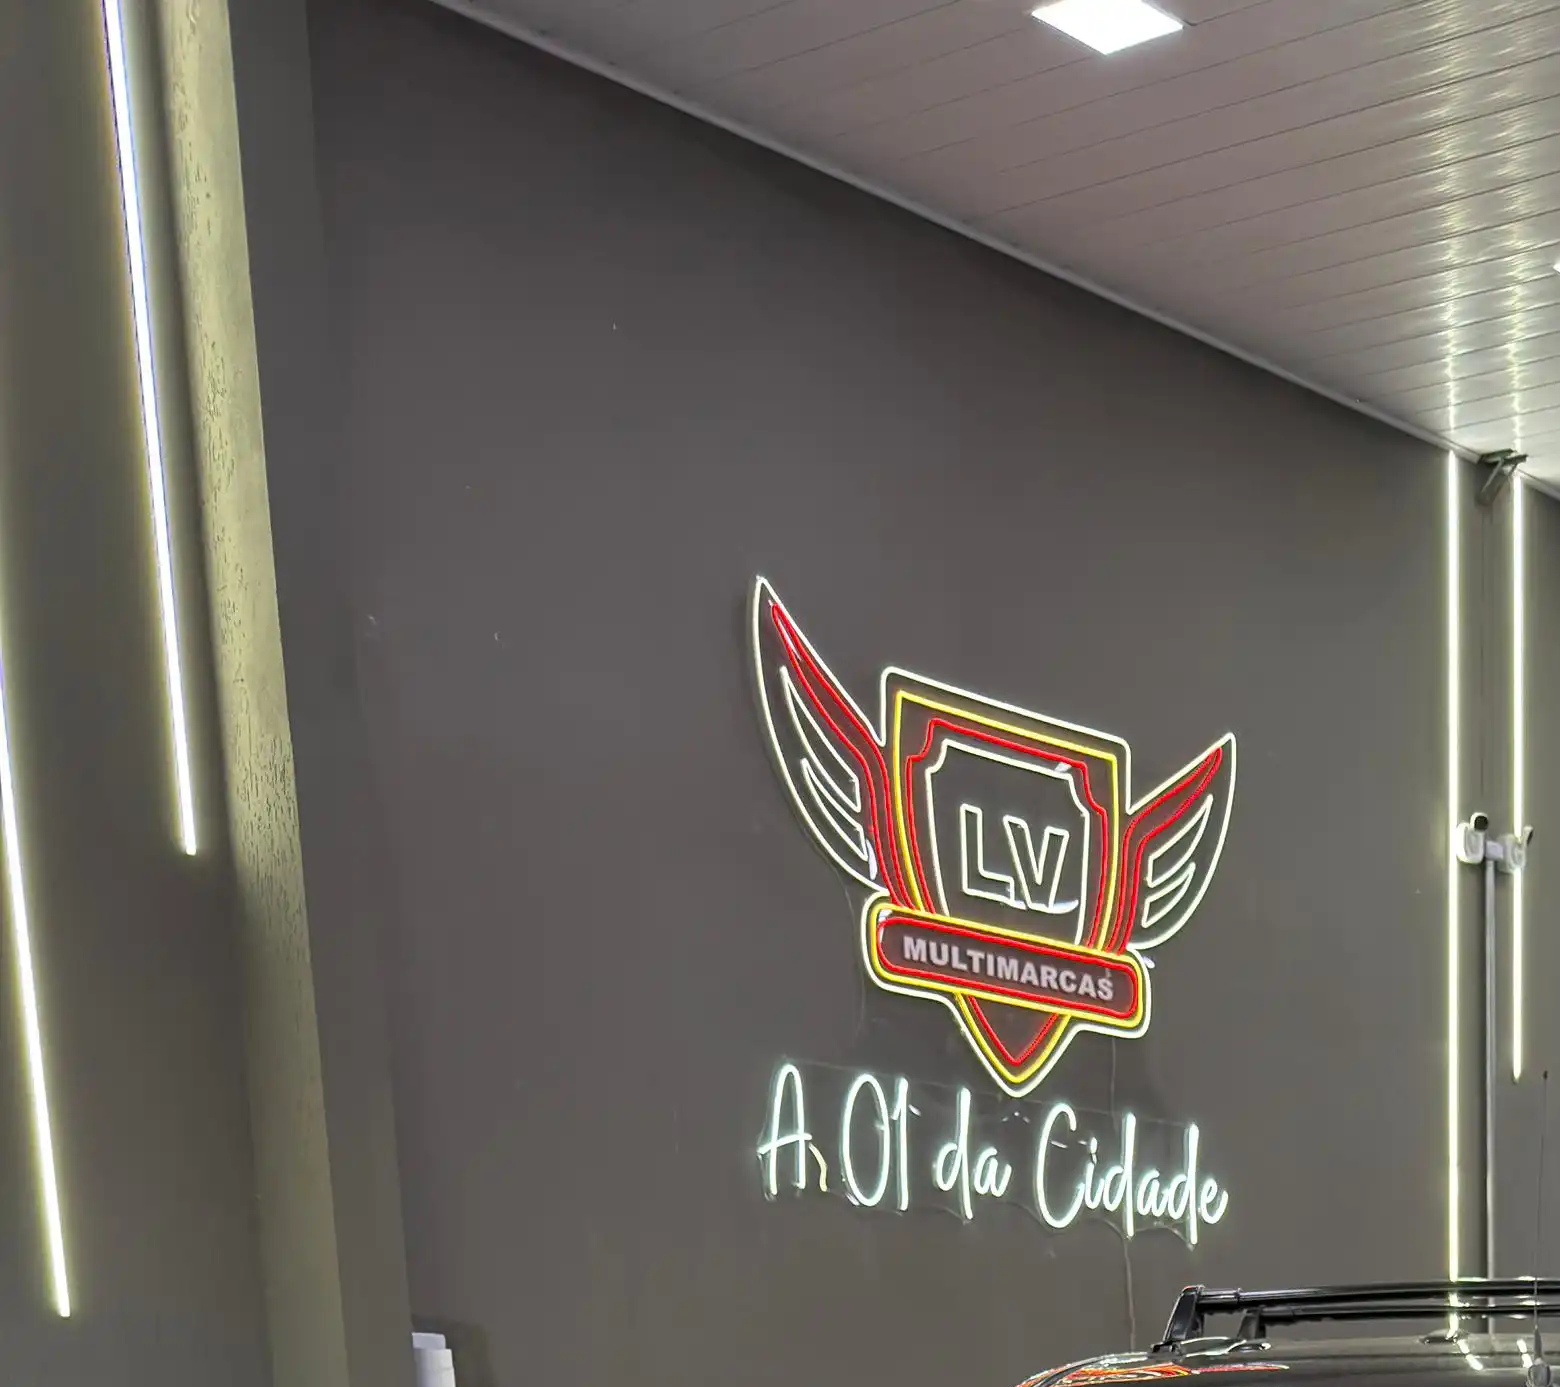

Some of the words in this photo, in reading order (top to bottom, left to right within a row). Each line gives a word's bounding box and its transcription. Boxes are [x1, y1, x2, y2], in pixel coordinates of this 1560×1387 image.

[960, 803, 1071, 912] LV
[903, 934, 1114, 1001] MULTIMARCAS
[757, 1063, 812, 1198] A
[933, 1087, 1011, 1220] da
[1036, 1102, 1229, 1246] Cidade
